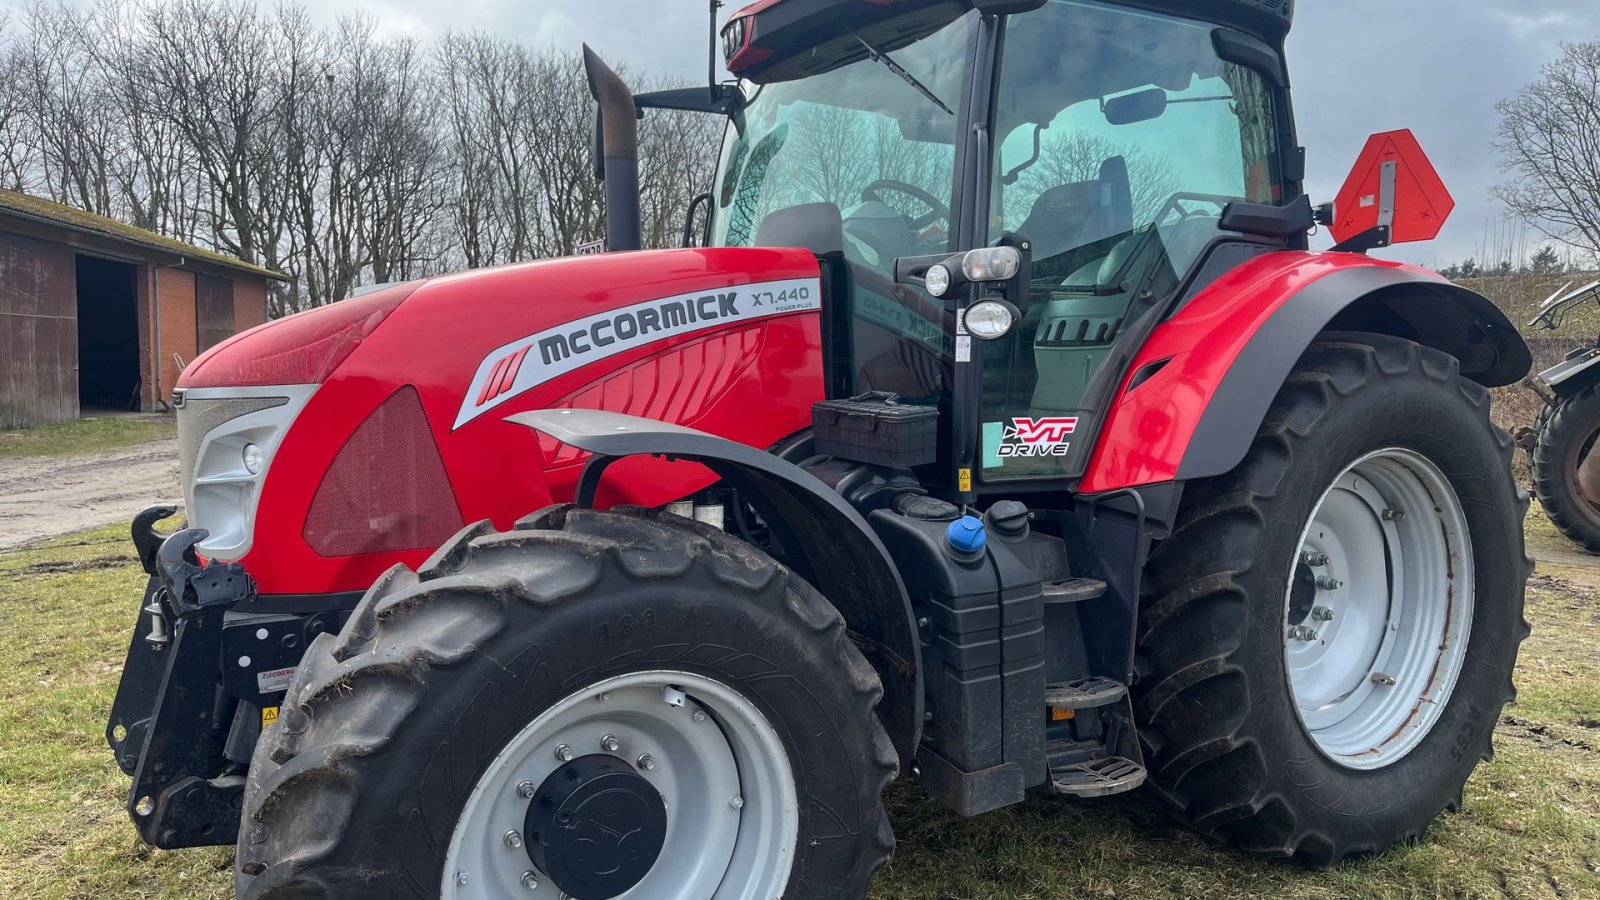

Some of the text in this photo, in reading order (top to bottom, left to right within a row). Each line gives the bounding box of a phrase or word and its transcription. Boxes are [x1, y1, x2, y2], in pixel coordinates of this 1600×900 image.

[751, 287, 809, 307] X7.440
[538, 292, 740, 365] McCORMICK
[997, 444, 1068, 456] DRIVE
